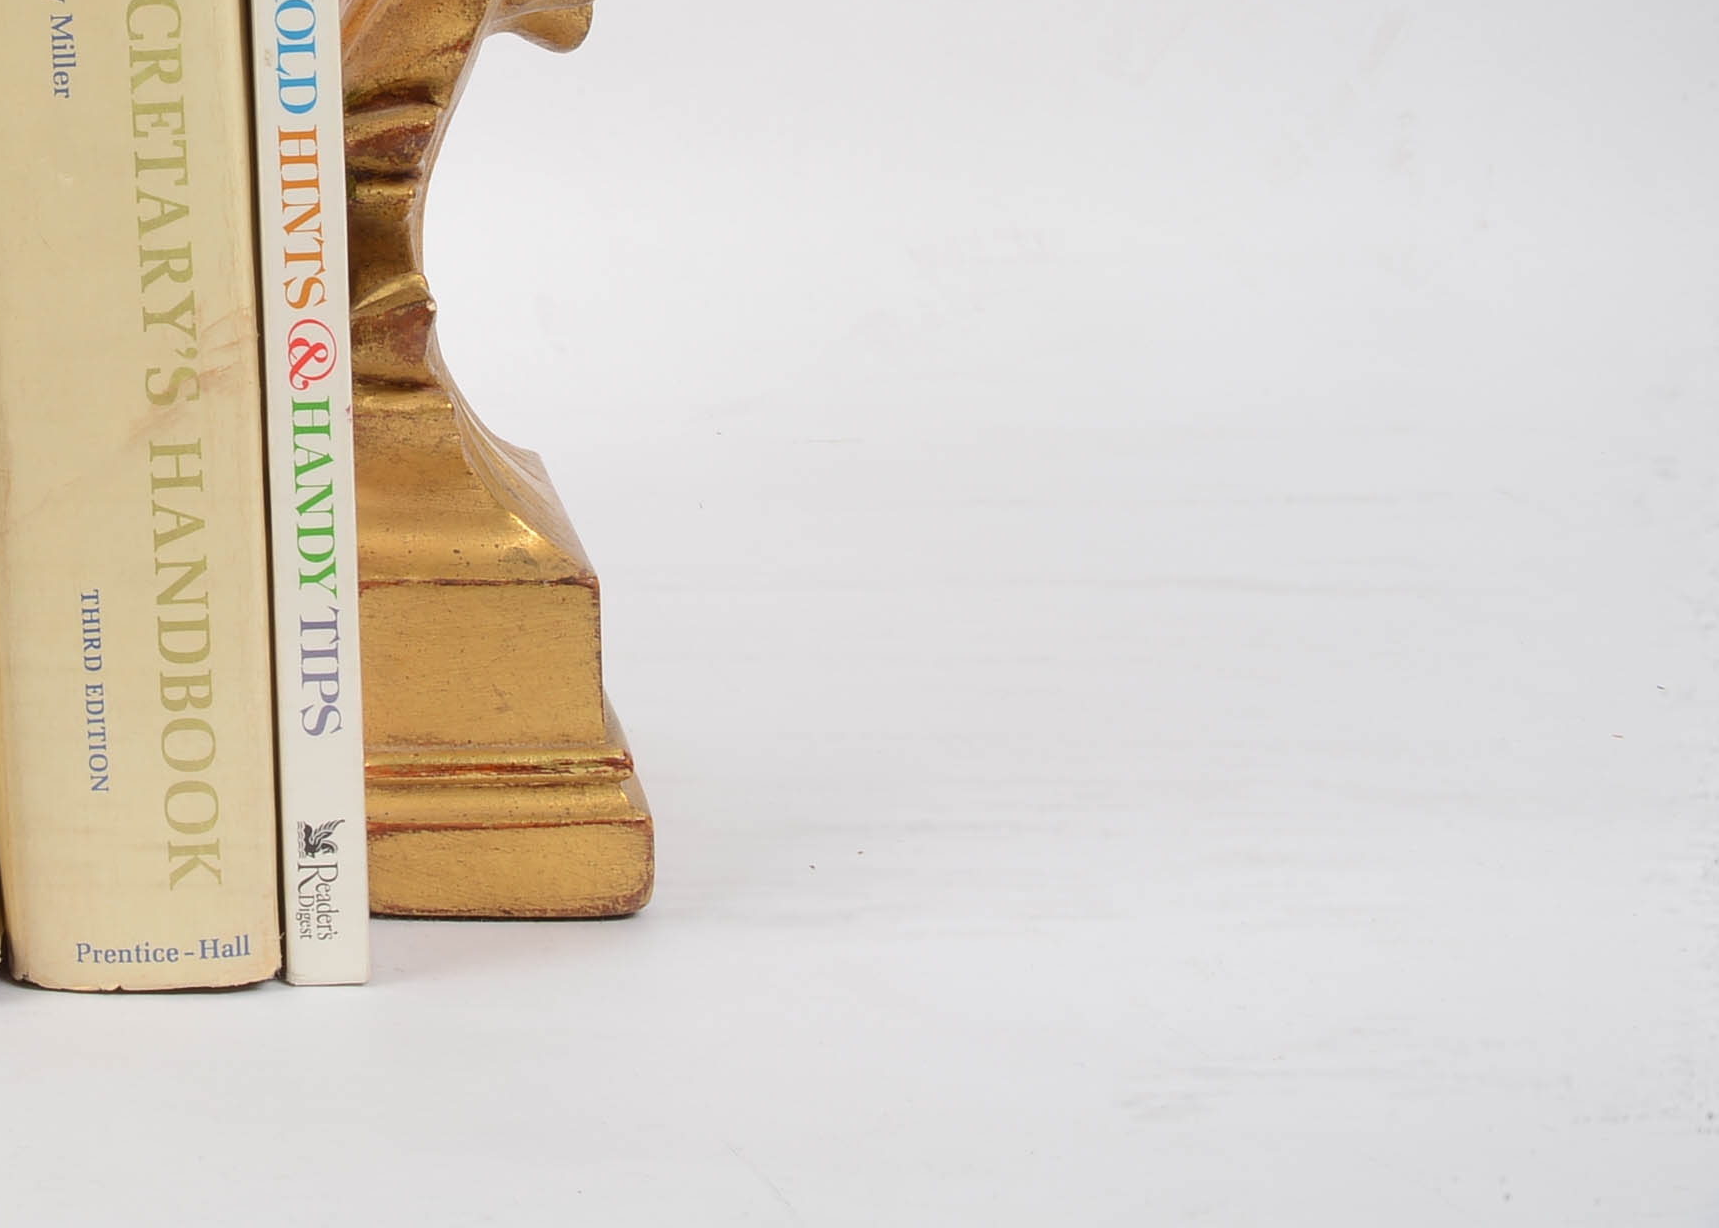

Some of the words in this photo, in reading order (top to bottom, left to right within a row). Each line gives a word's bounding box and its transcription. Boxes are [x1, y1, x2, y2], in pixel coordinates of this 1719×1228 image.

[50, 13, 76, 99] Miller
[278, 124, 327, 309] HINTS
[287, 318, 337, 391] &
[291, 395, 338, 599] HANDY
[81, 589, 103, 672] THIRD
[148, 438, 222, 891] HANDBOOK
[299, 606, 343, 737] TIPS
[85, 683, 109, 792] EDITION
[296, 895, 315, 940] Digest
[297, 862, 339, 940] Reader's
